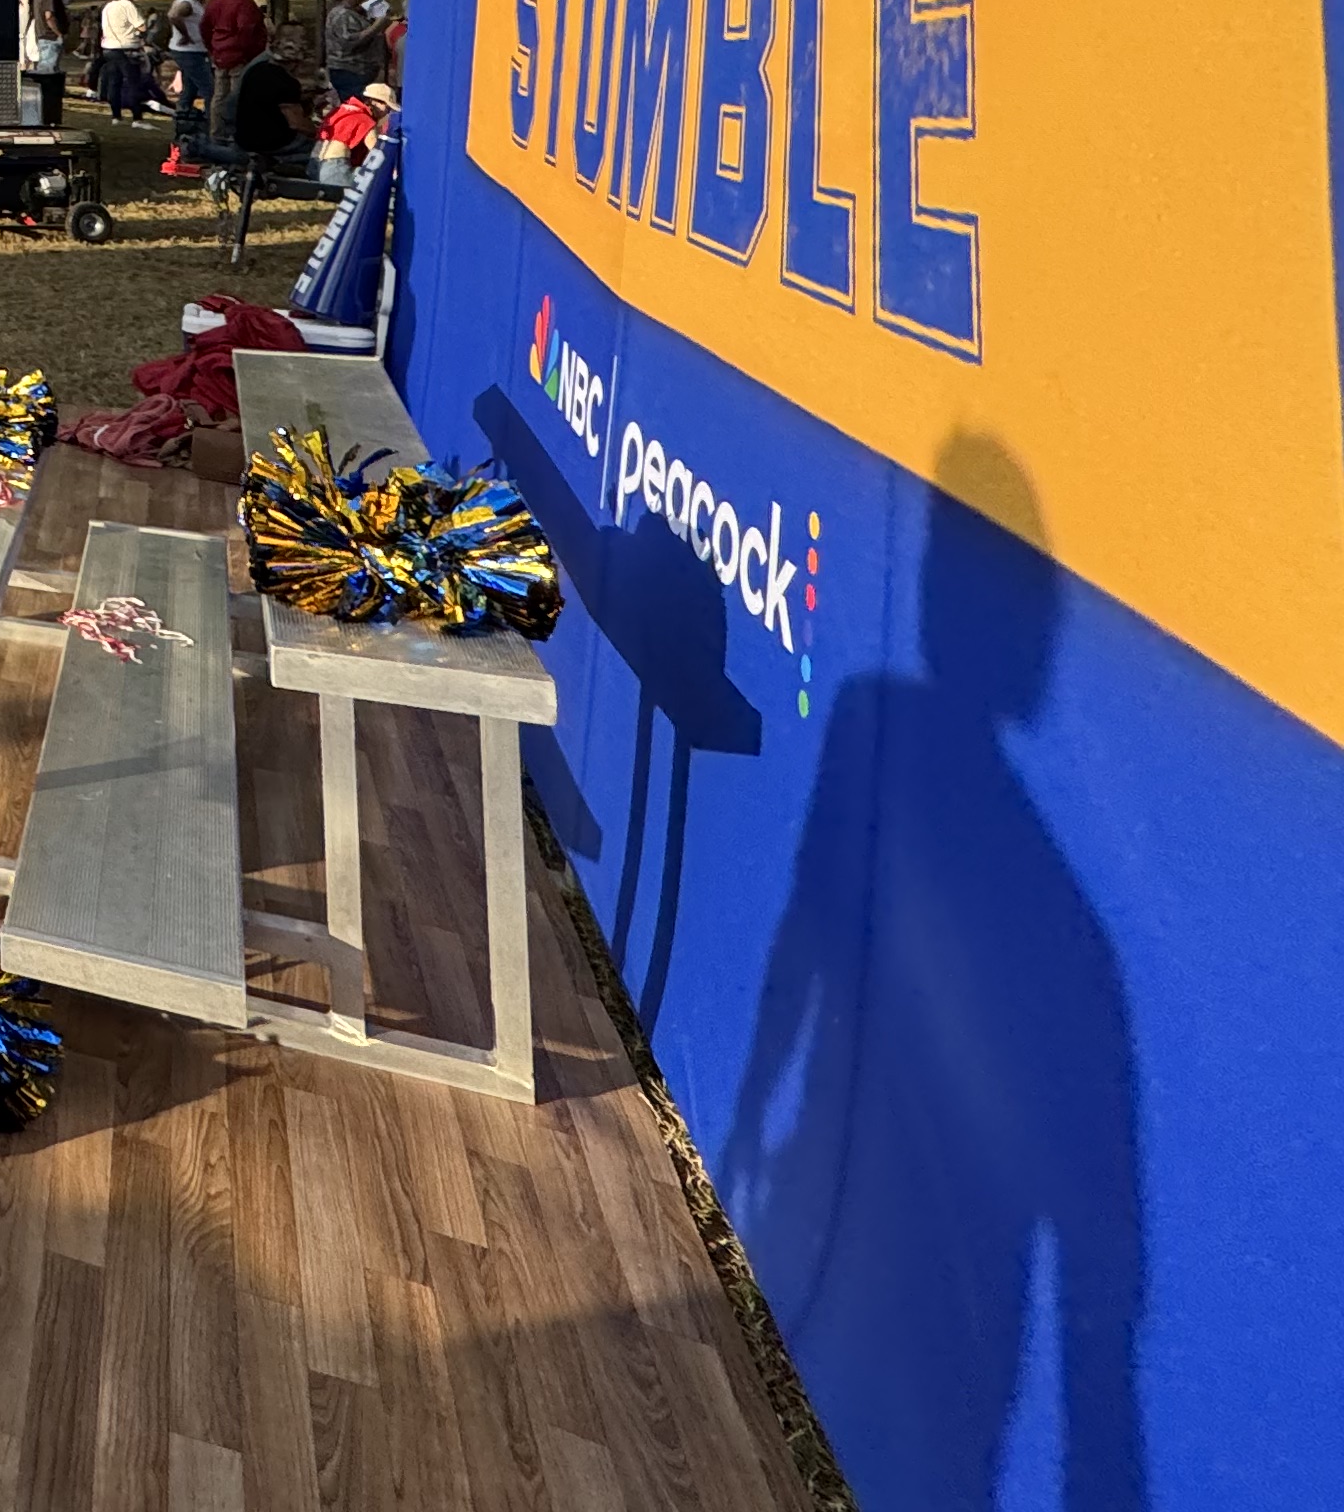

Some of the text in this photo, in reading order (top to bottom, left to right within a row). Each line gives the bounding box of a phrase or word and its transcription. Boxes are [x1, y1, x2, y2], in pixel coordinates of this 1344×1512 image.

[294, 148, 386, 294] STUMBLE
[557, 341, 798, 655] NBC peacock
